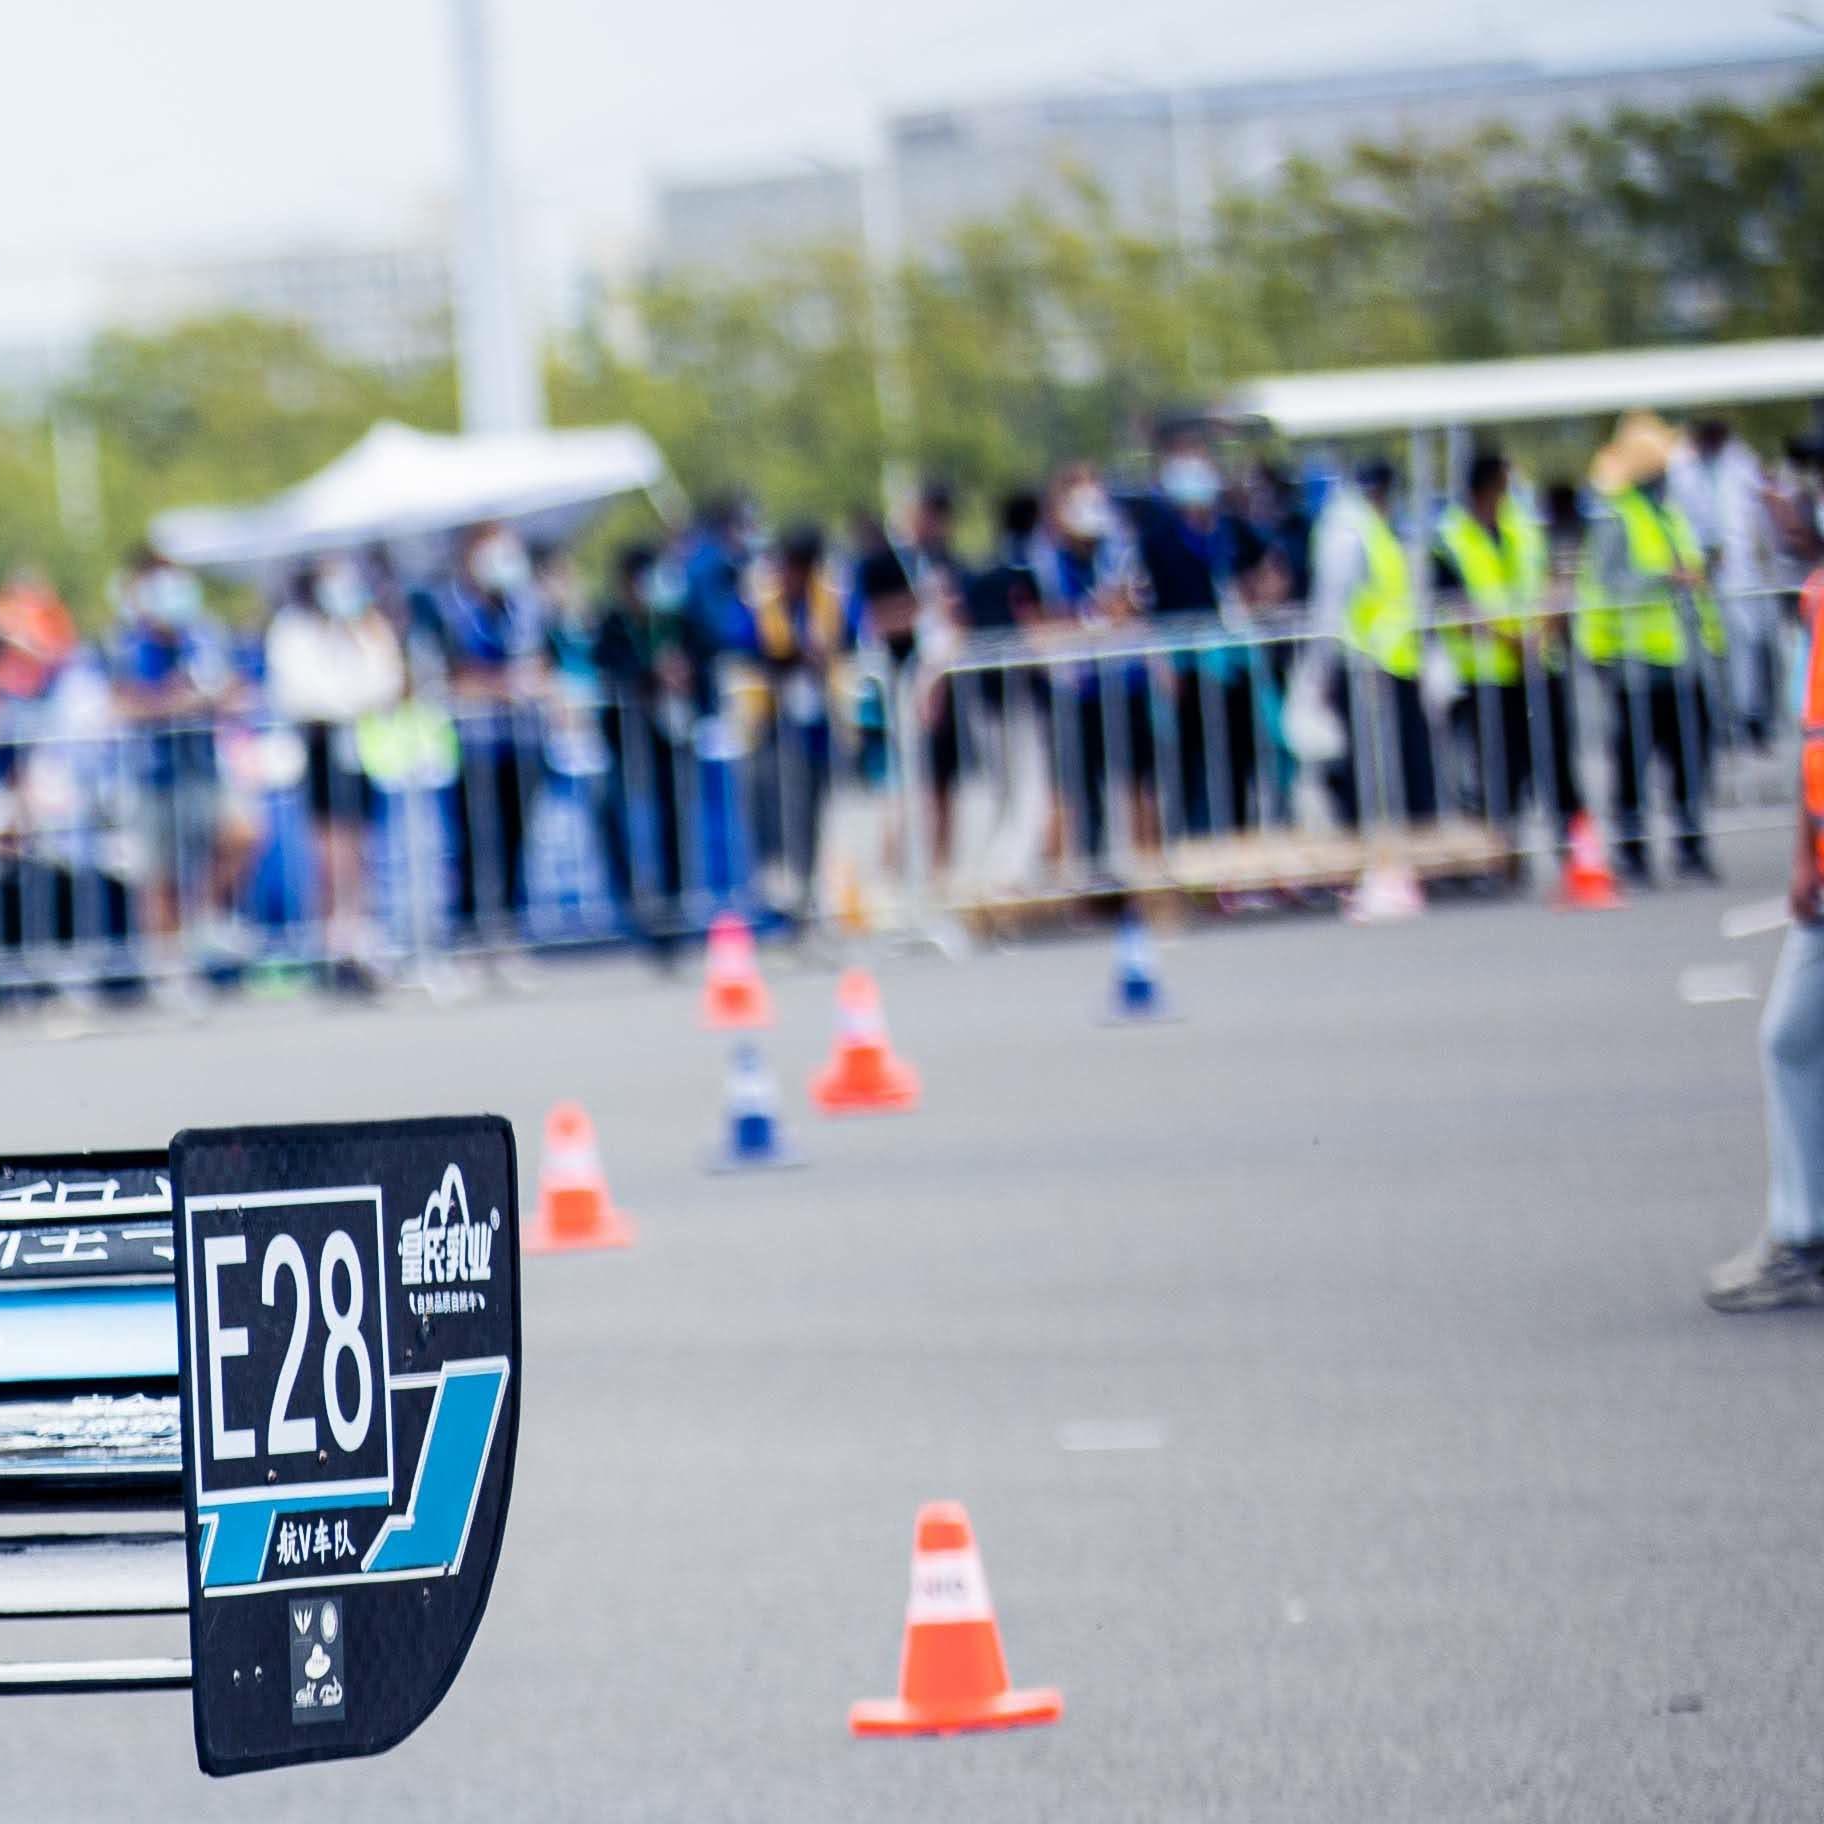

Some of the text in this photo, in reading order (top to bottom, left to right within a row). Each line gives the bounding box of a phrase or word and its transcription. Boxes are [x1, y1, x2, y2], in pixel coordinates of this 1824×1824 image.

[204, 1229, 373, 1461] E28
[276, 1517, 357, 1566] 航V车队
